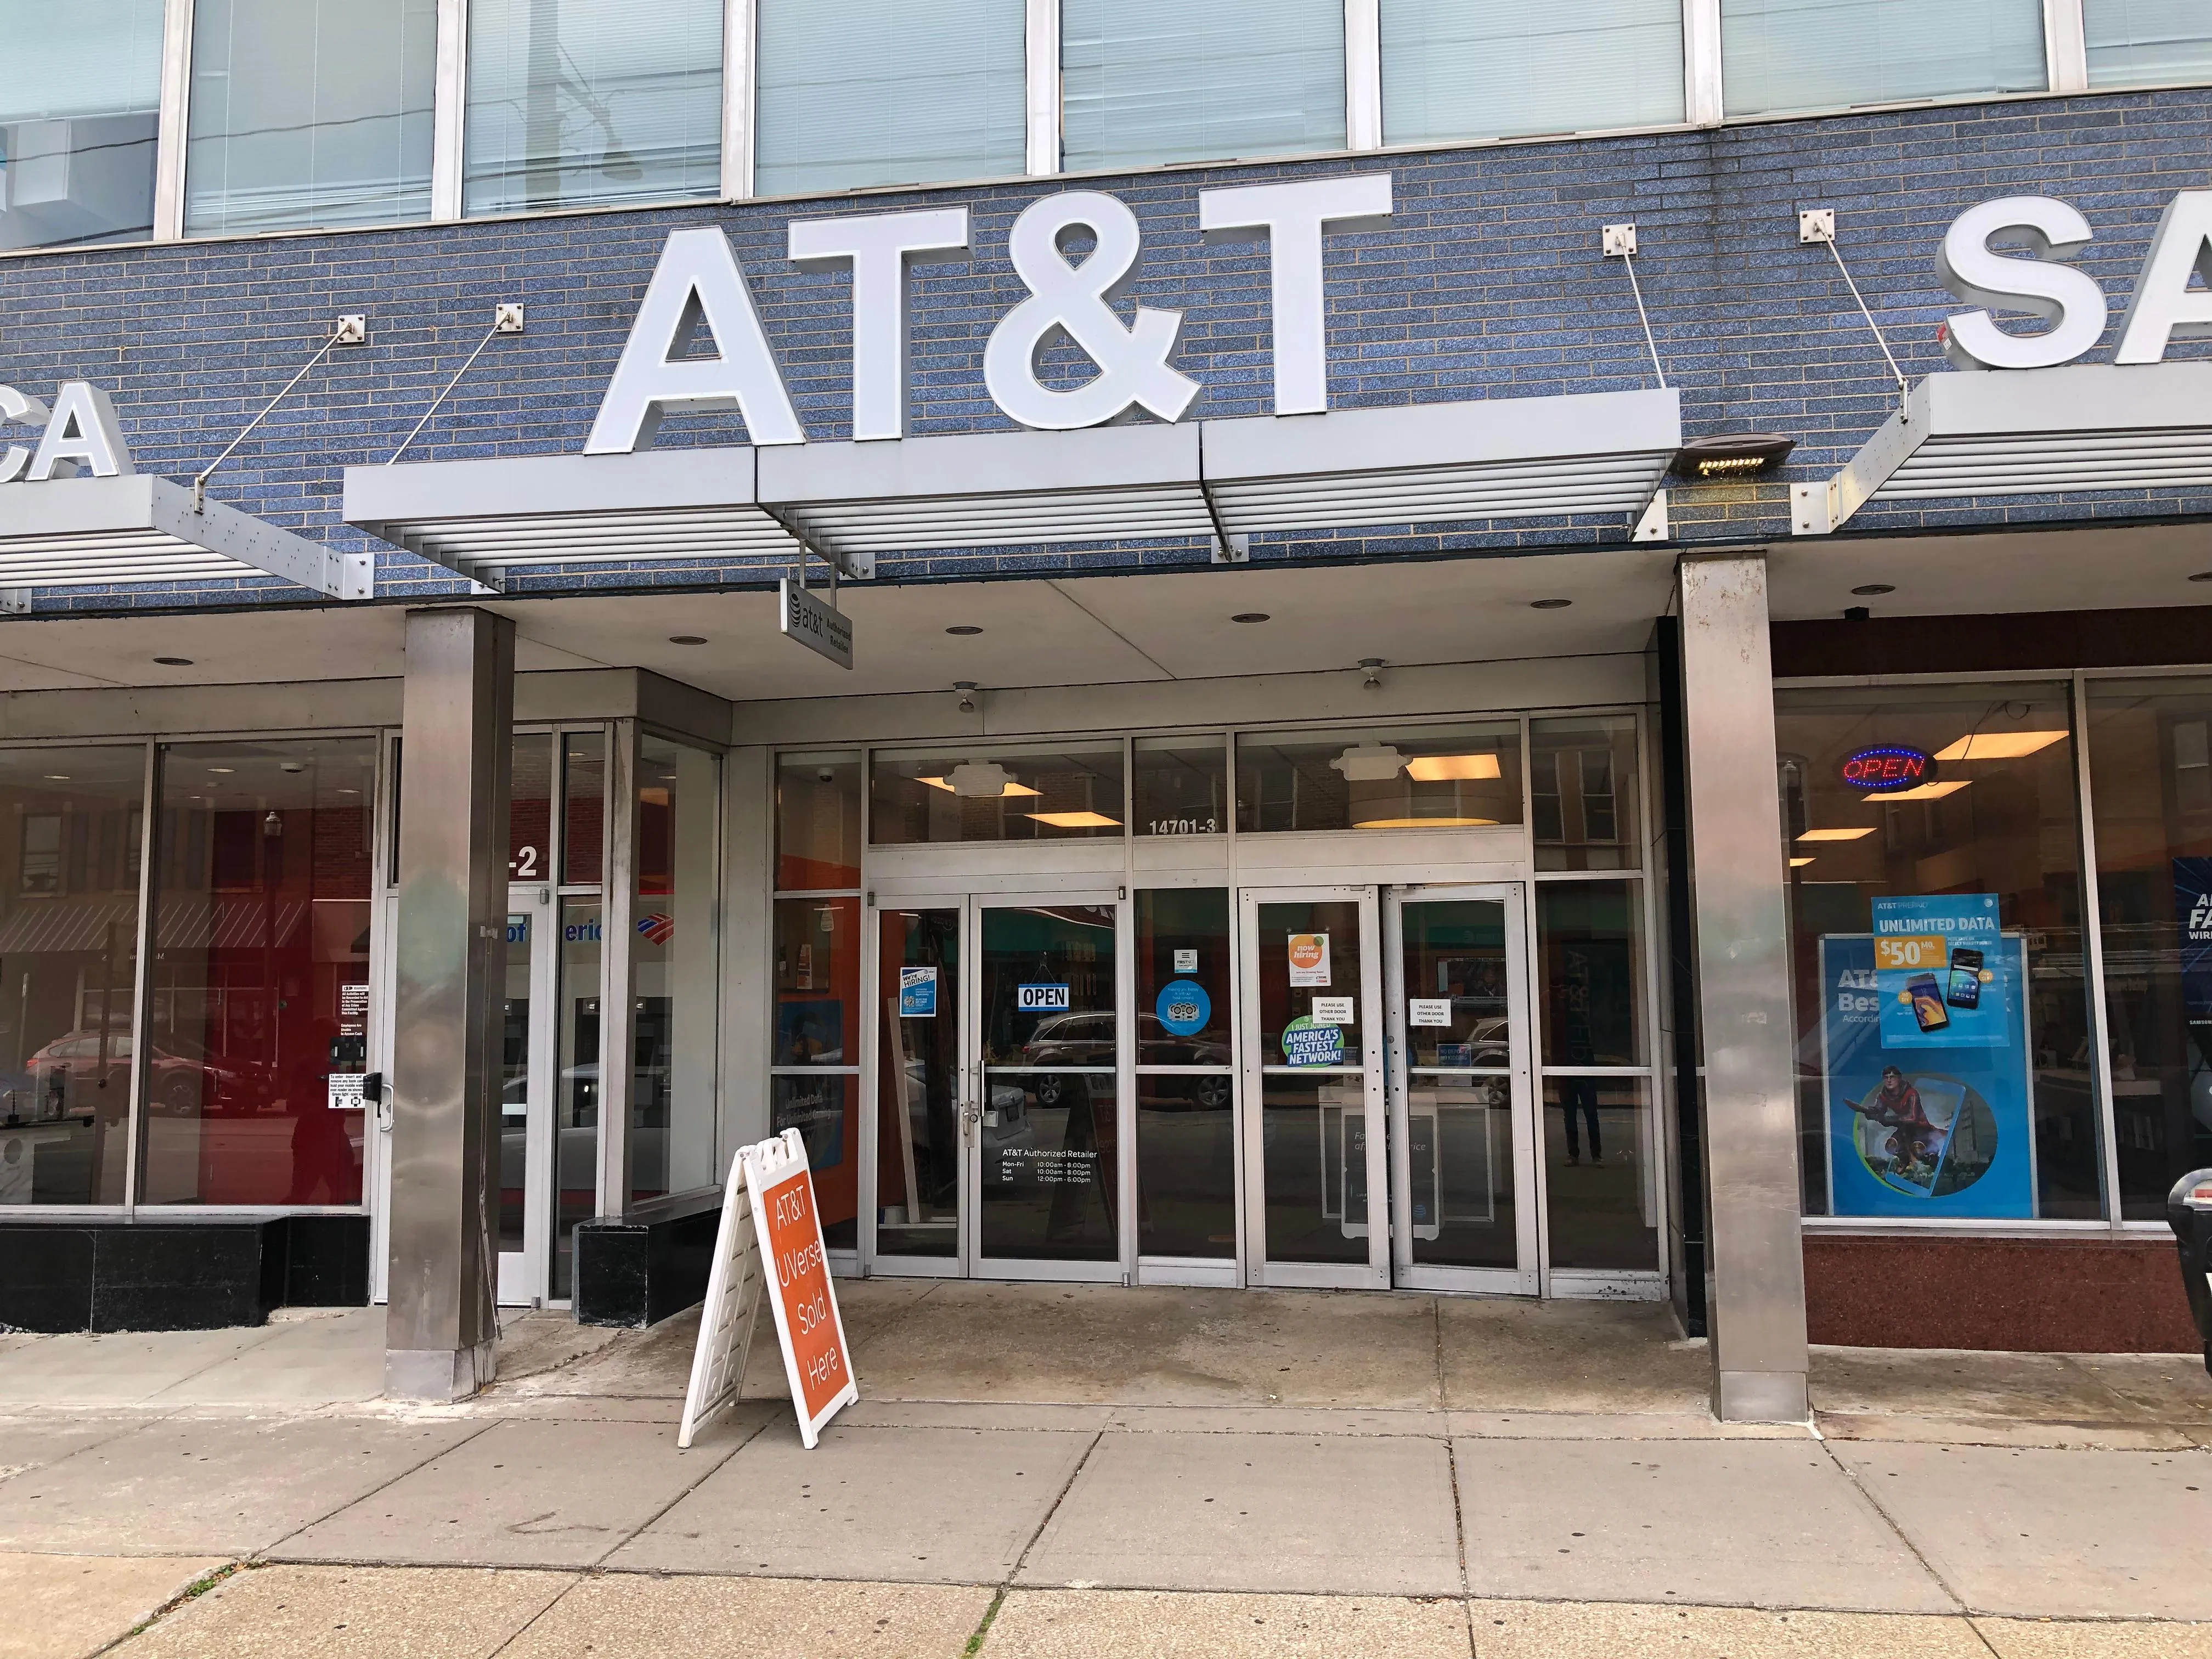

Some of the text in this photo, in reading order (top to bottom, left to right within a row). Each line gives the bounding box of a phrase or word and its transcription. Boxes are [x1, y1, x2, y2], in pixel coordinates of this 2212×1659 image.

[583, 172, 1393, 455] AT&T
[803, 606, 823, 638] at&t
[826, 617, 851, 641] Authorized
[830, 635, 849, 654] Retailer
[1843, 758, 1925, 778] OPEN
[1149, 818, 1216, 834] 14701-3
[507, 923, 526, 943] of
[1879, 917, 1995, 933] UNLIMITED DATA
[1294, 951, 1319, 960] hiring
[1880, 939, 1921, 966] $50
[904, 974, 930, 988] HIRING!
[1023, 988, 1065, 1006] OPEN
[1838, 993, 1880, 1011] Bes
[1843, 1014, 1881, 1023] Accordin
[1286, 1029, 1339, 1043] AMERICA'S
[1293, 1040, 1335, 1054] FASTEST
[1289, 1050, 1341, 1064] NETWORK!
[1068, 1150, 1097, 1158] Retailer
[776, 1184, 806, 1231] AT&T
[776, 1239, 821, 1288] UVerse
[798, 1287, 827, 1335] Sold
[807, 1347, 838, 1391] Here
